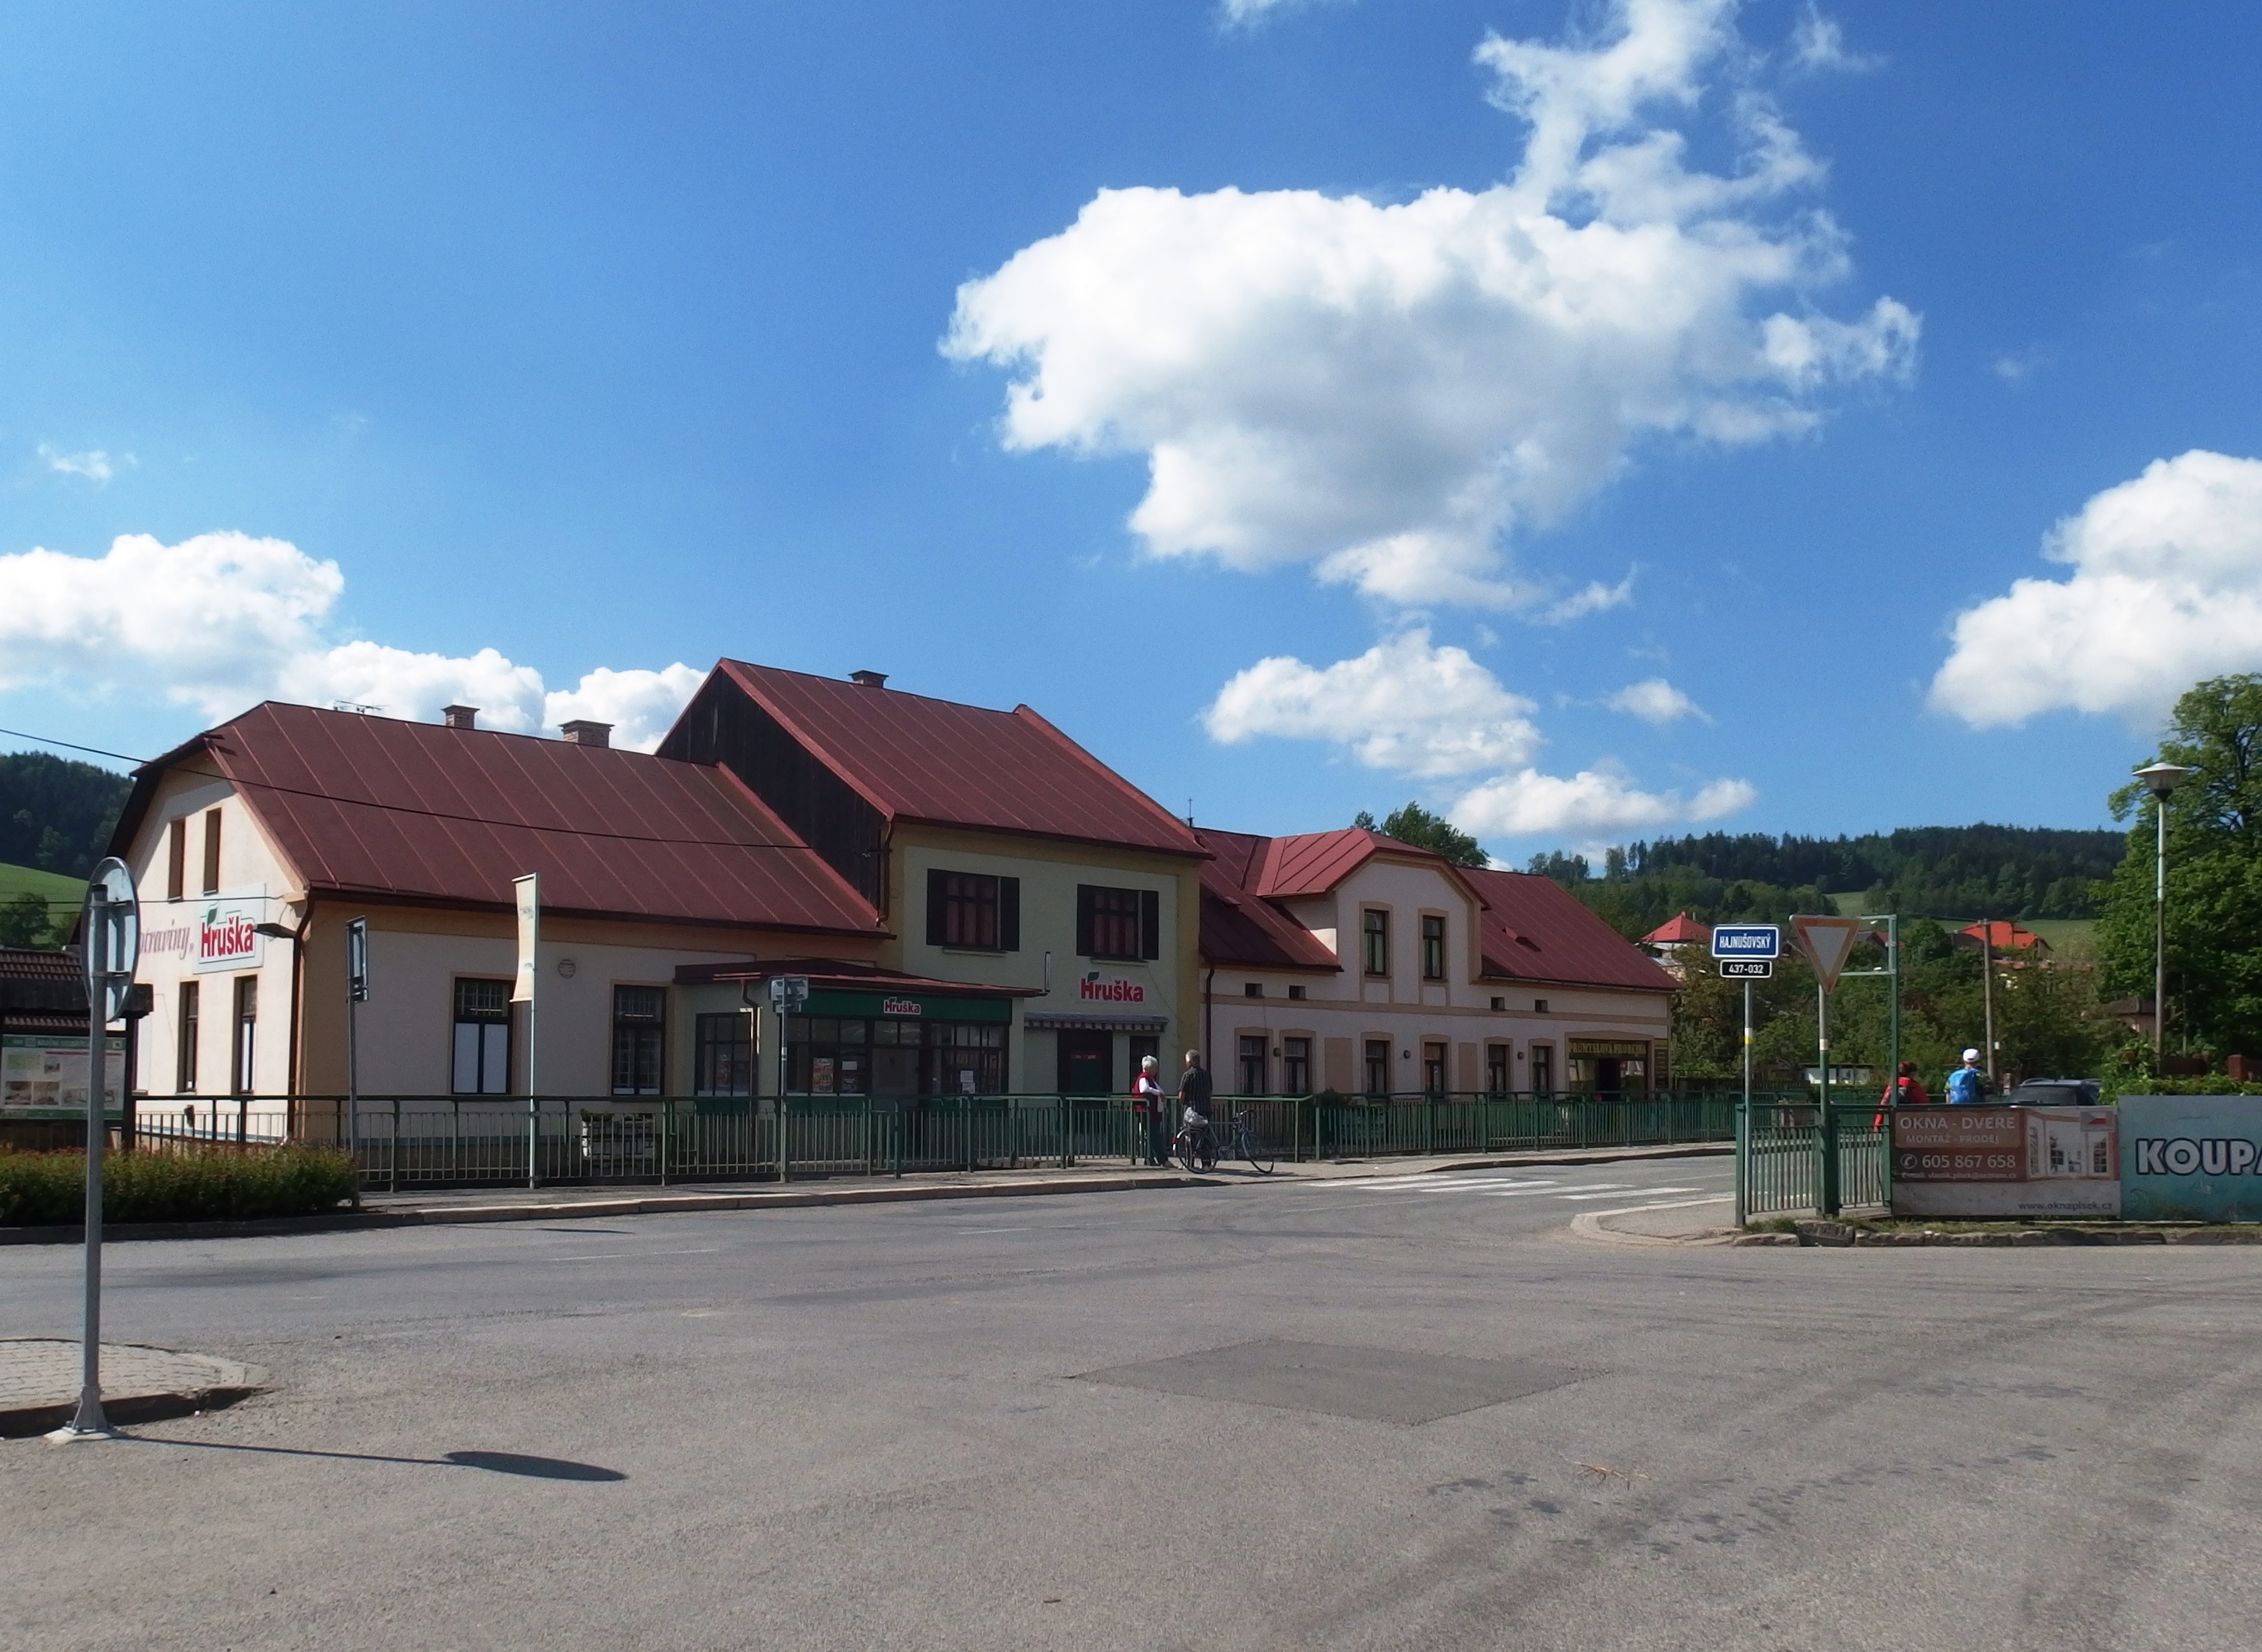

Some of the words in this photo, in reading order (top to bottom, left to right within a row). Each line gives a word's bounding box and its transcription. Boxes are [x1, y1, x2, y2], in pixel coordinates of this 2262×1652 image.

[200, 915, 253, 958] Hruška
[1719, 933, 1771, 949] HAJNUŠOVSKÝ
[1729, 964, 1764, 974] 437-032
[1080, 977, 1144, 1002] Hruška
[884, 1001, 920, 1014] Hruška
[1900, 1117, 1948, 1129] OKNA
[1959, 1134, 1999, 1145] PRODEJ
[1922, 1155, 1950, 1168] 605
[1954, 1155, 1983, 1168] 867
[1987, 1155, 2016, 1168] 658
